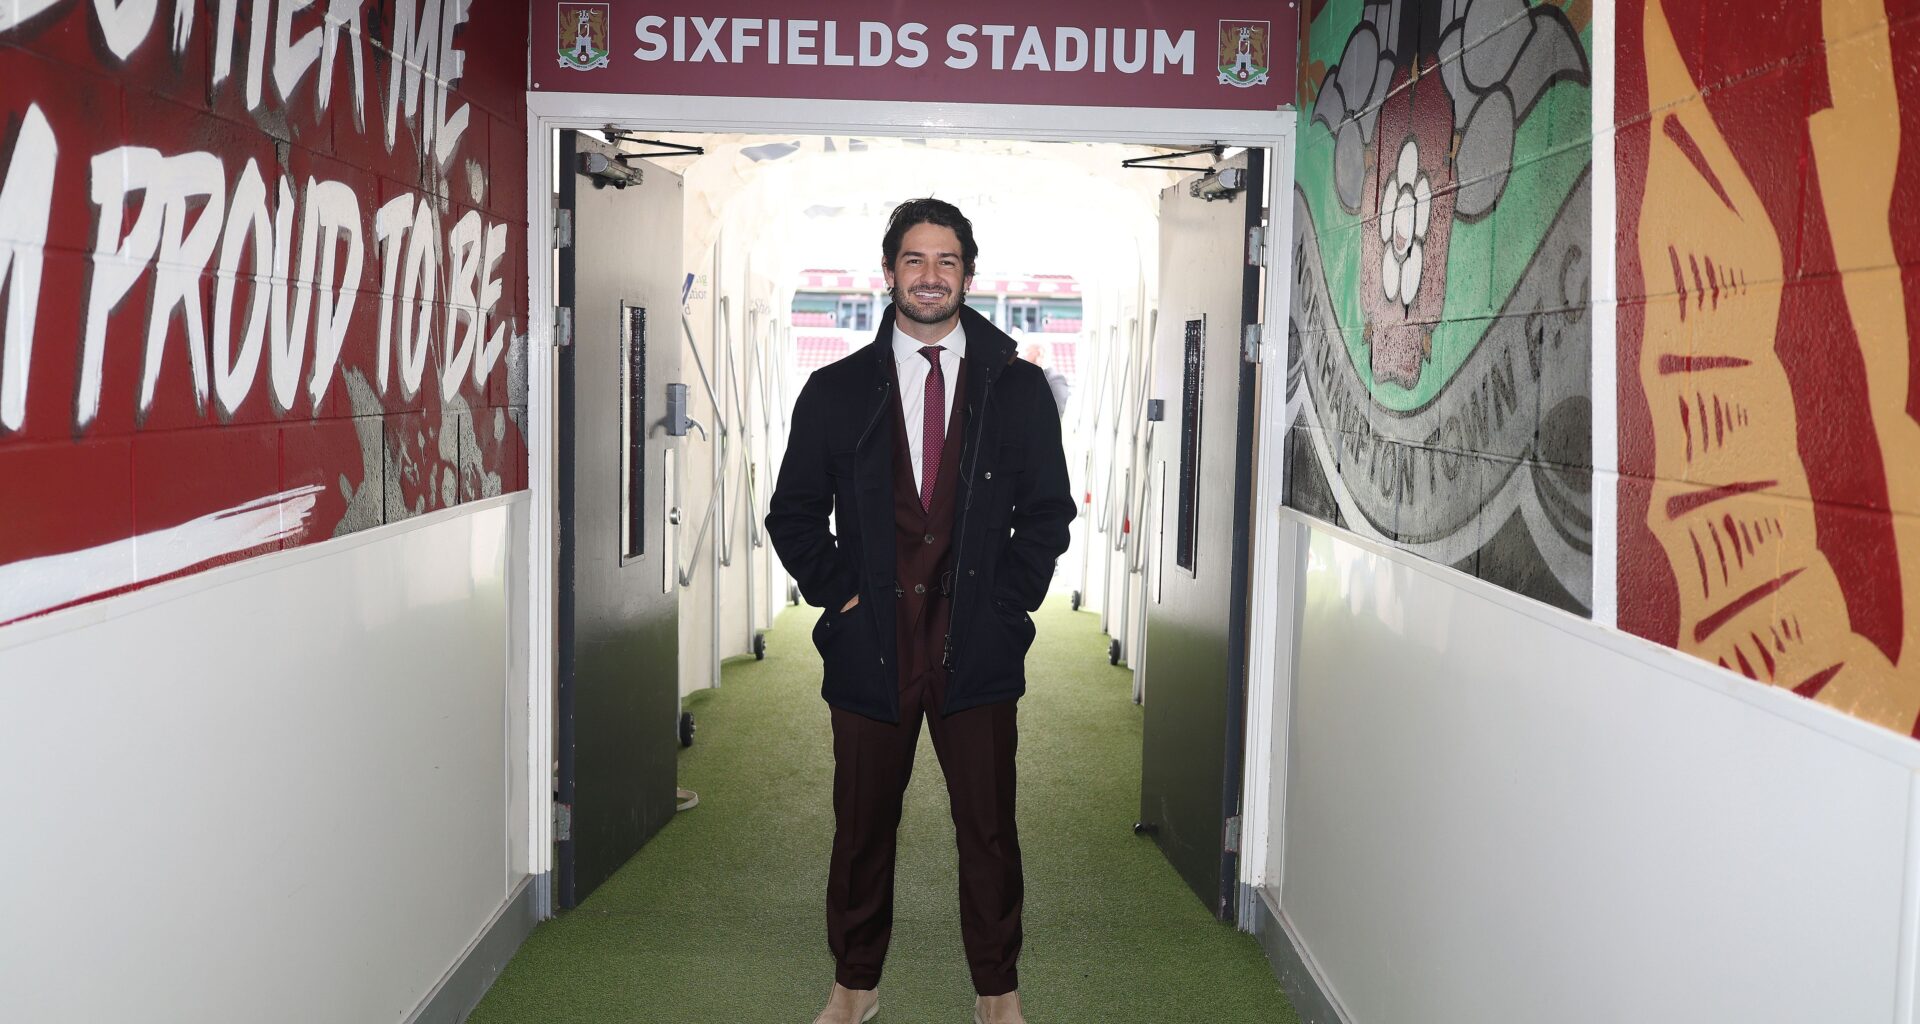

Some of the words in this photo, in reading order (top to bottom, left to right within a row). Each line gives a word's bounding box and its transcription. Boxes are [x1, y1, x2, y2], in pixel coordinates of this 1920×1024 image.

[633, 15, 929, 68] SIXFIELDS
[944, 23, 1195, 75] STADIUM
[77, 146, 364, 425] PROUD
[376, 192, 436, 395] TO
[441, 210, 508, 404] BE
[1294, 233, 1415, 505] NORTHAMPTON
[1423, 345, 1518, 495] TOWN
